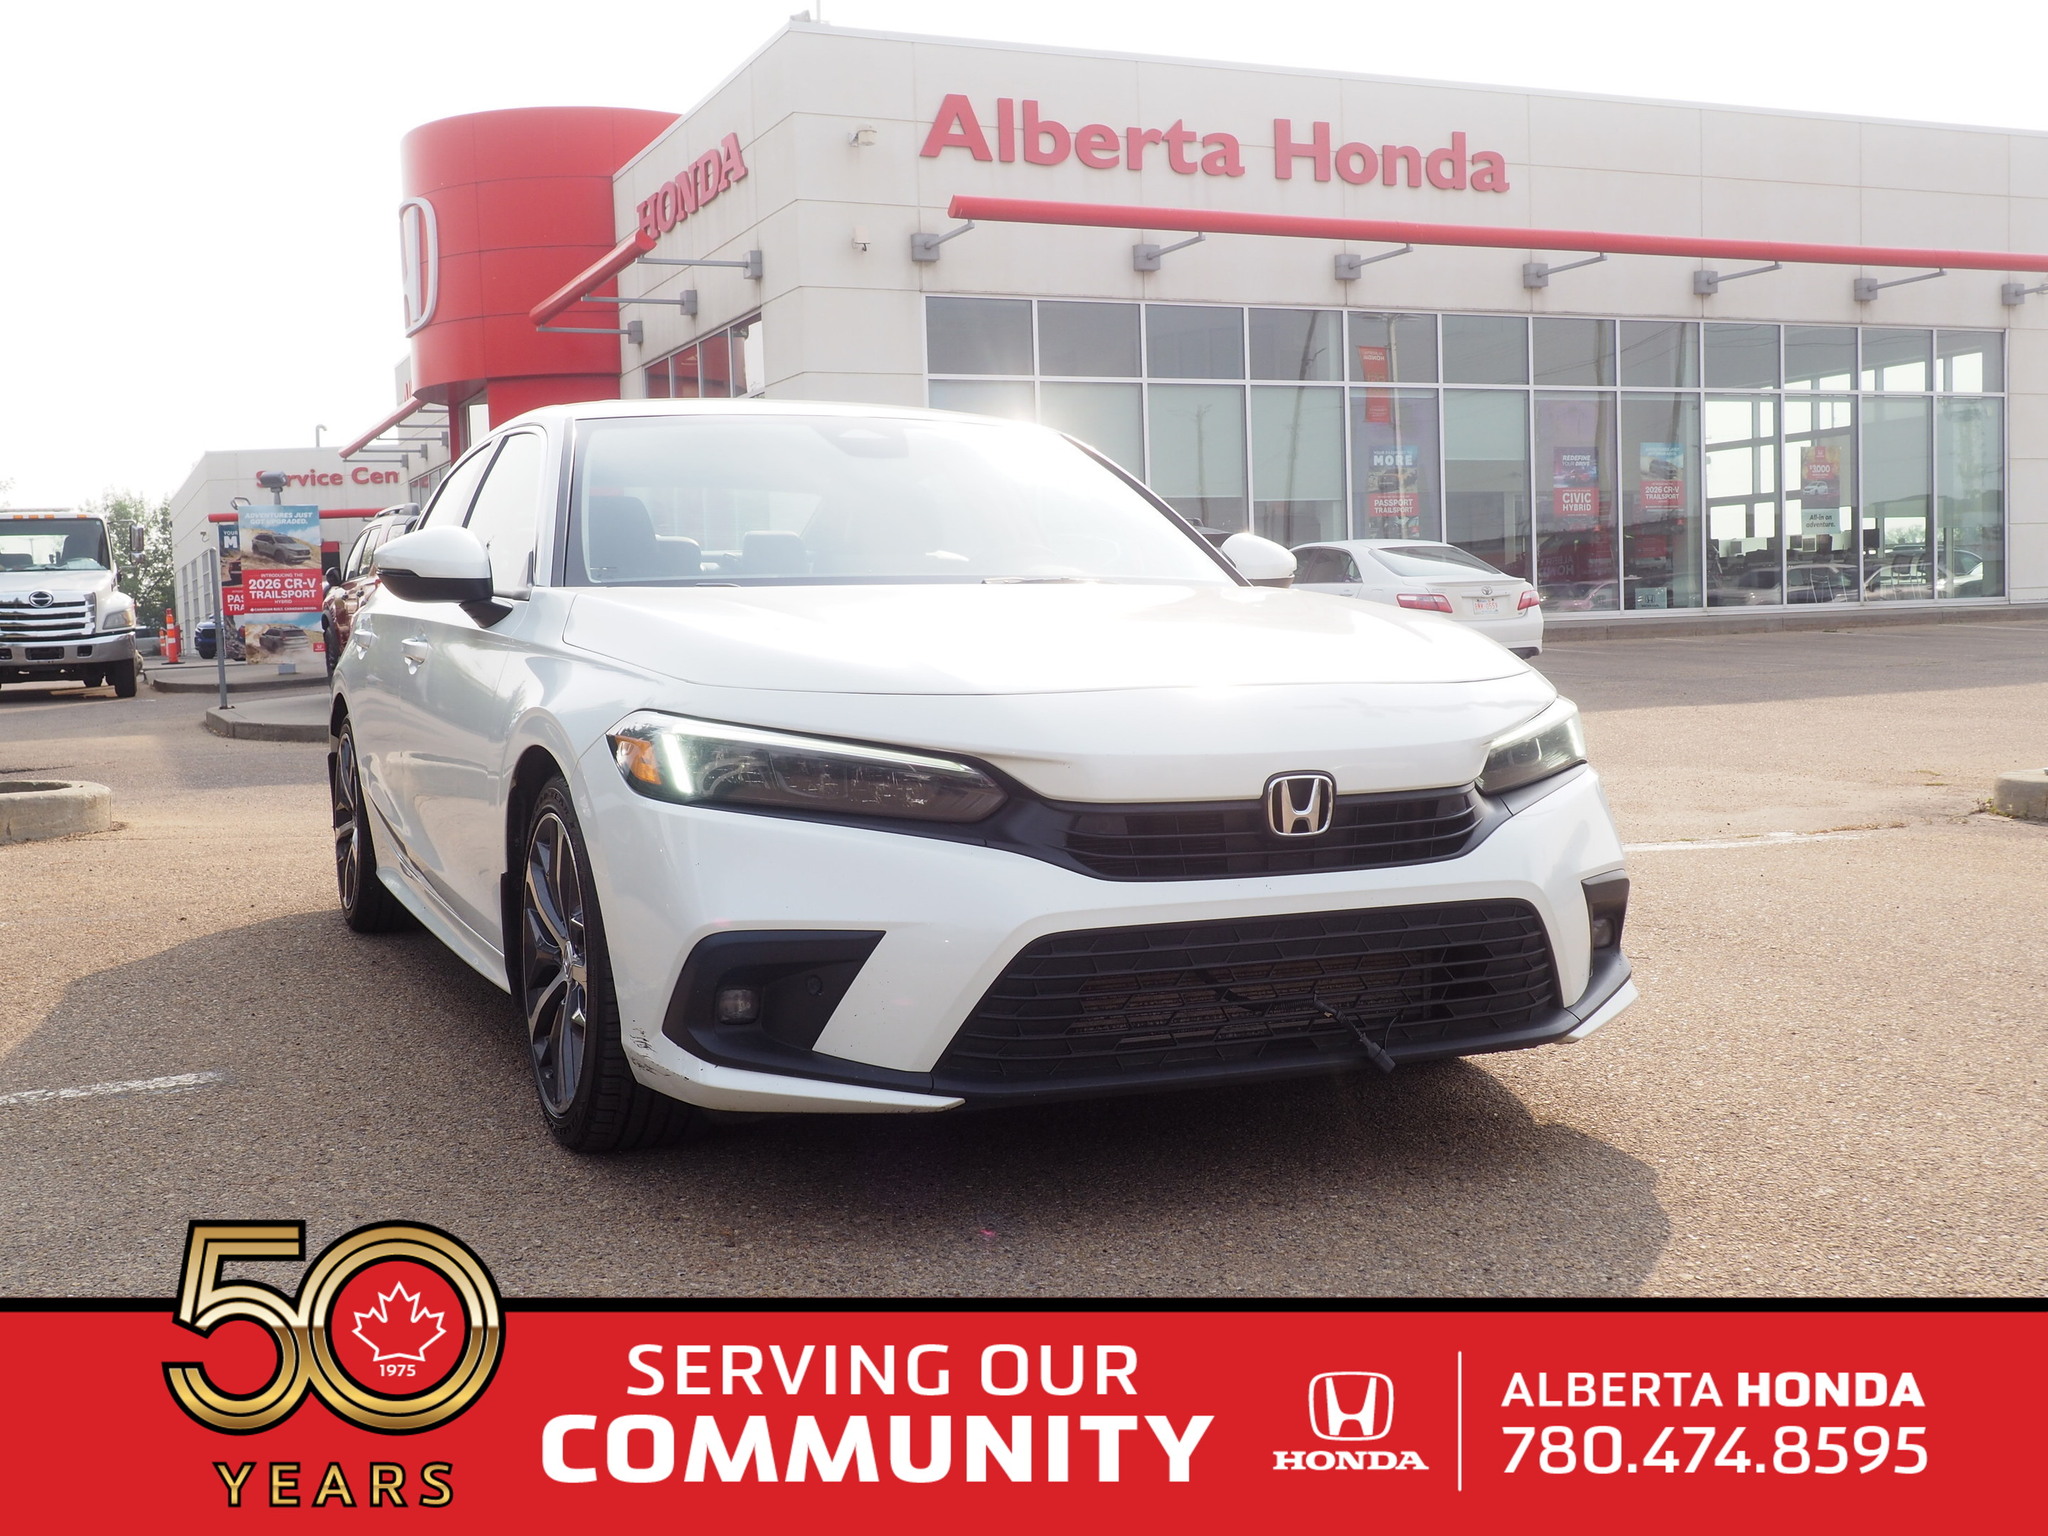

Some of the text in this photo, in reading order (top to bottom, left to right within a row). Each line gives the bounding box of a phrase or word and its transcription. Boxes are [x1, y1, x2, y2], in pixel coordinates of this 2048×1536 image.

[919, 93, 1511, 193] Alberta Honda
[636, 132, 748, 241] HONDA
[1373, 455, 1413, 466] MORE
[256, 467, 399, 488] Srvice Cen
[1562, 492, 1592, 504] CIVIC
[1374, 506, 1413, 514] TRAILSPORT
[248, 577, 317, 590] 2026 CR-V
[249, 589, 317, 599] TRAILSPORT
